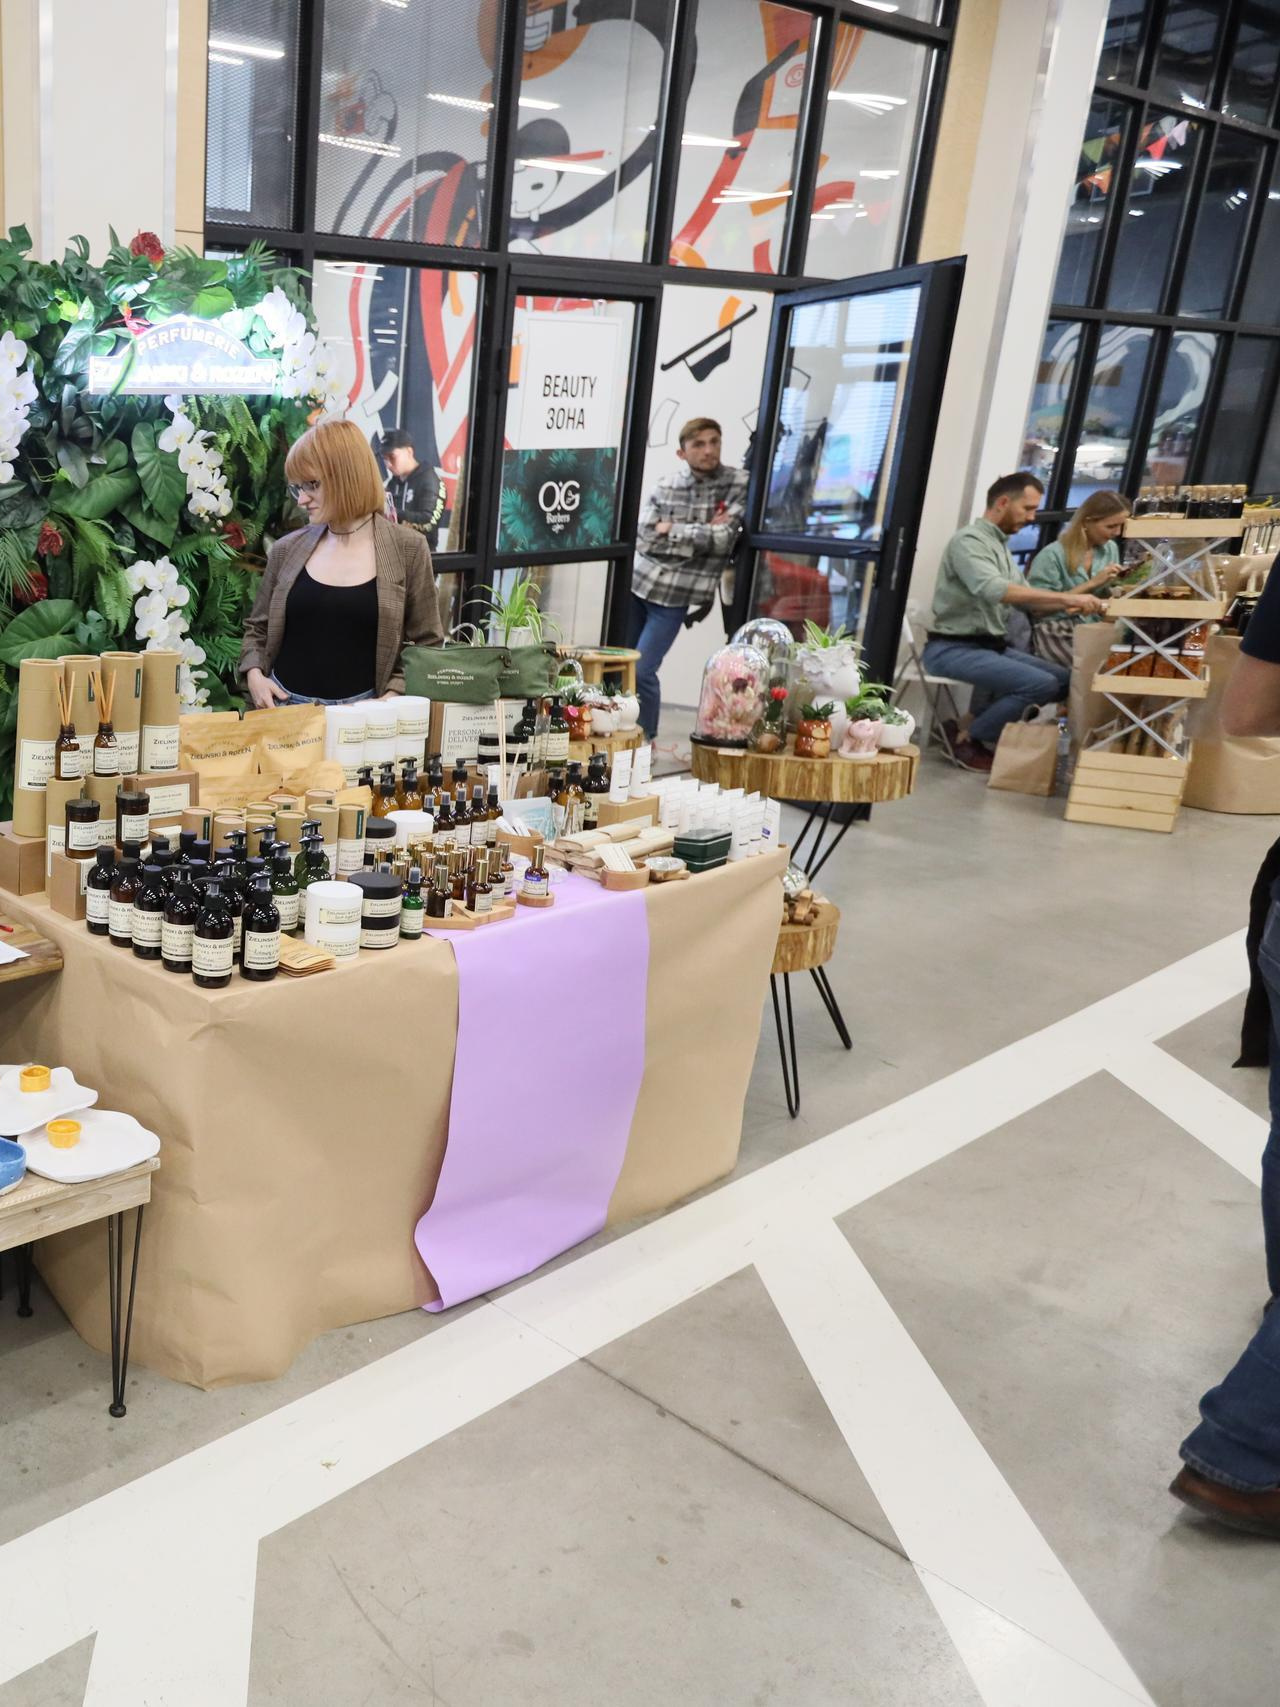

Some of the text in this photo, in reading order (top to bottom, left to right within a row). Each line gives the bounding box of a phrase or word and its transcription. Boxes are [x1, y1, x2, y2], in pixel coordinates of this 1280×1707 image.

[137, 328, 240, 360] PERFUMERIE
[543, 374, 597, 399] BEAUTY
[546, 407, 585, 430] ЗОНА
[228, 746, 252, 757] ROZEN
